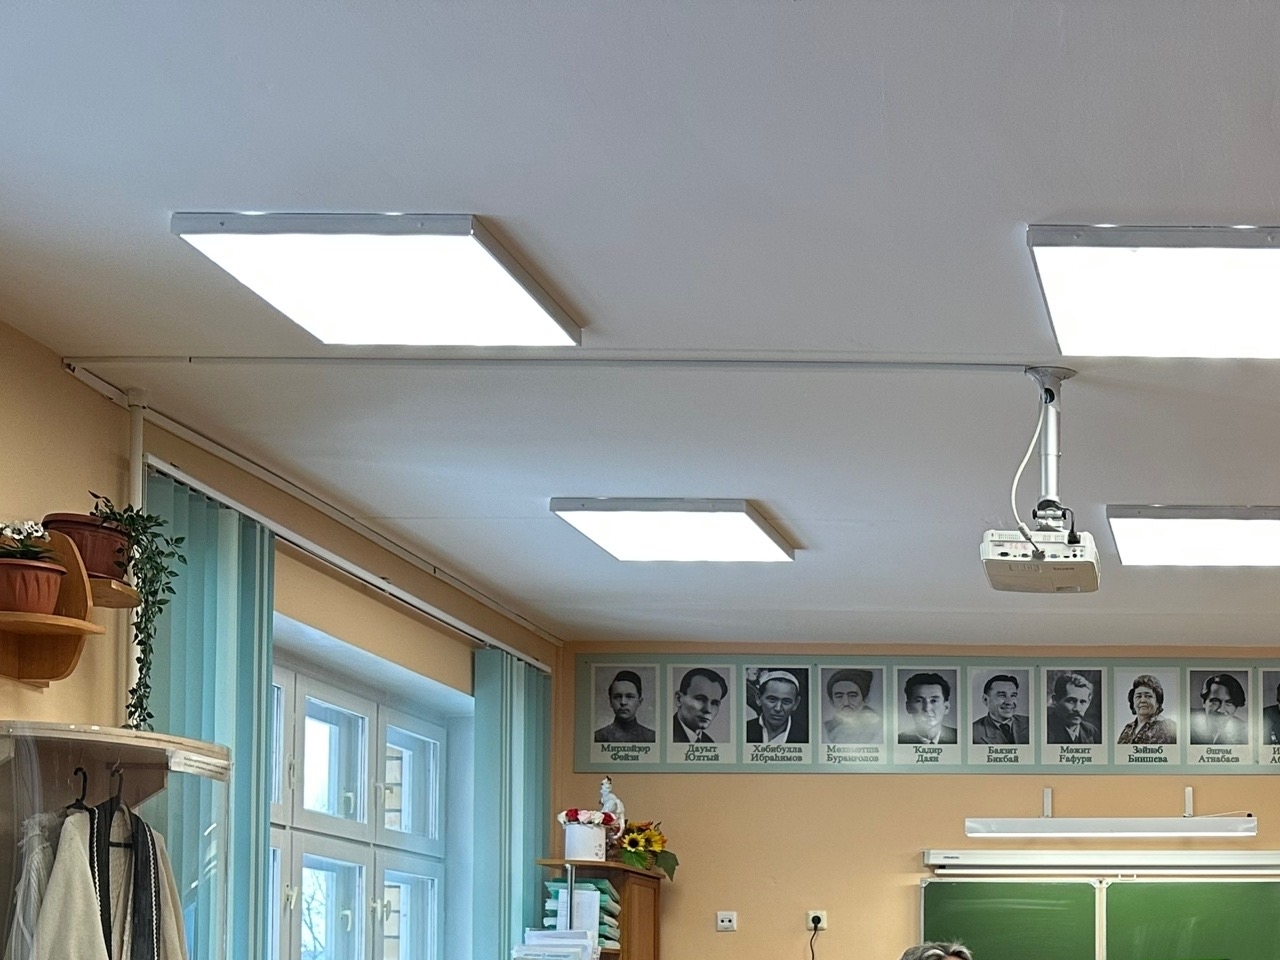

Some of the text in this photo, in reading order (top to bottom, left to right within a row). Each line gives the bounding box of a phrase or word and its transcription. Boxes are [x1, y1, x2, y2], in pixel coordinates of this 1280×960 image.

[687, 745, 717, 754] Дауыт
[752, 745, 803, 754] Хәбибулла
[988, 746, 1018, 755] Баязит
[685, 753, 720, 762] Юлтый
[751, 753, 803, 763] Ибраһимов
[916, 755, 939, 763] Даян
[987, 754, 1019, 763] Бикбай
[1059, 755, 1092, 764] Ғафури
[1128, 754, 1168, 763] Биишева
[1198, 755, 1240, 763] Атнабаев
